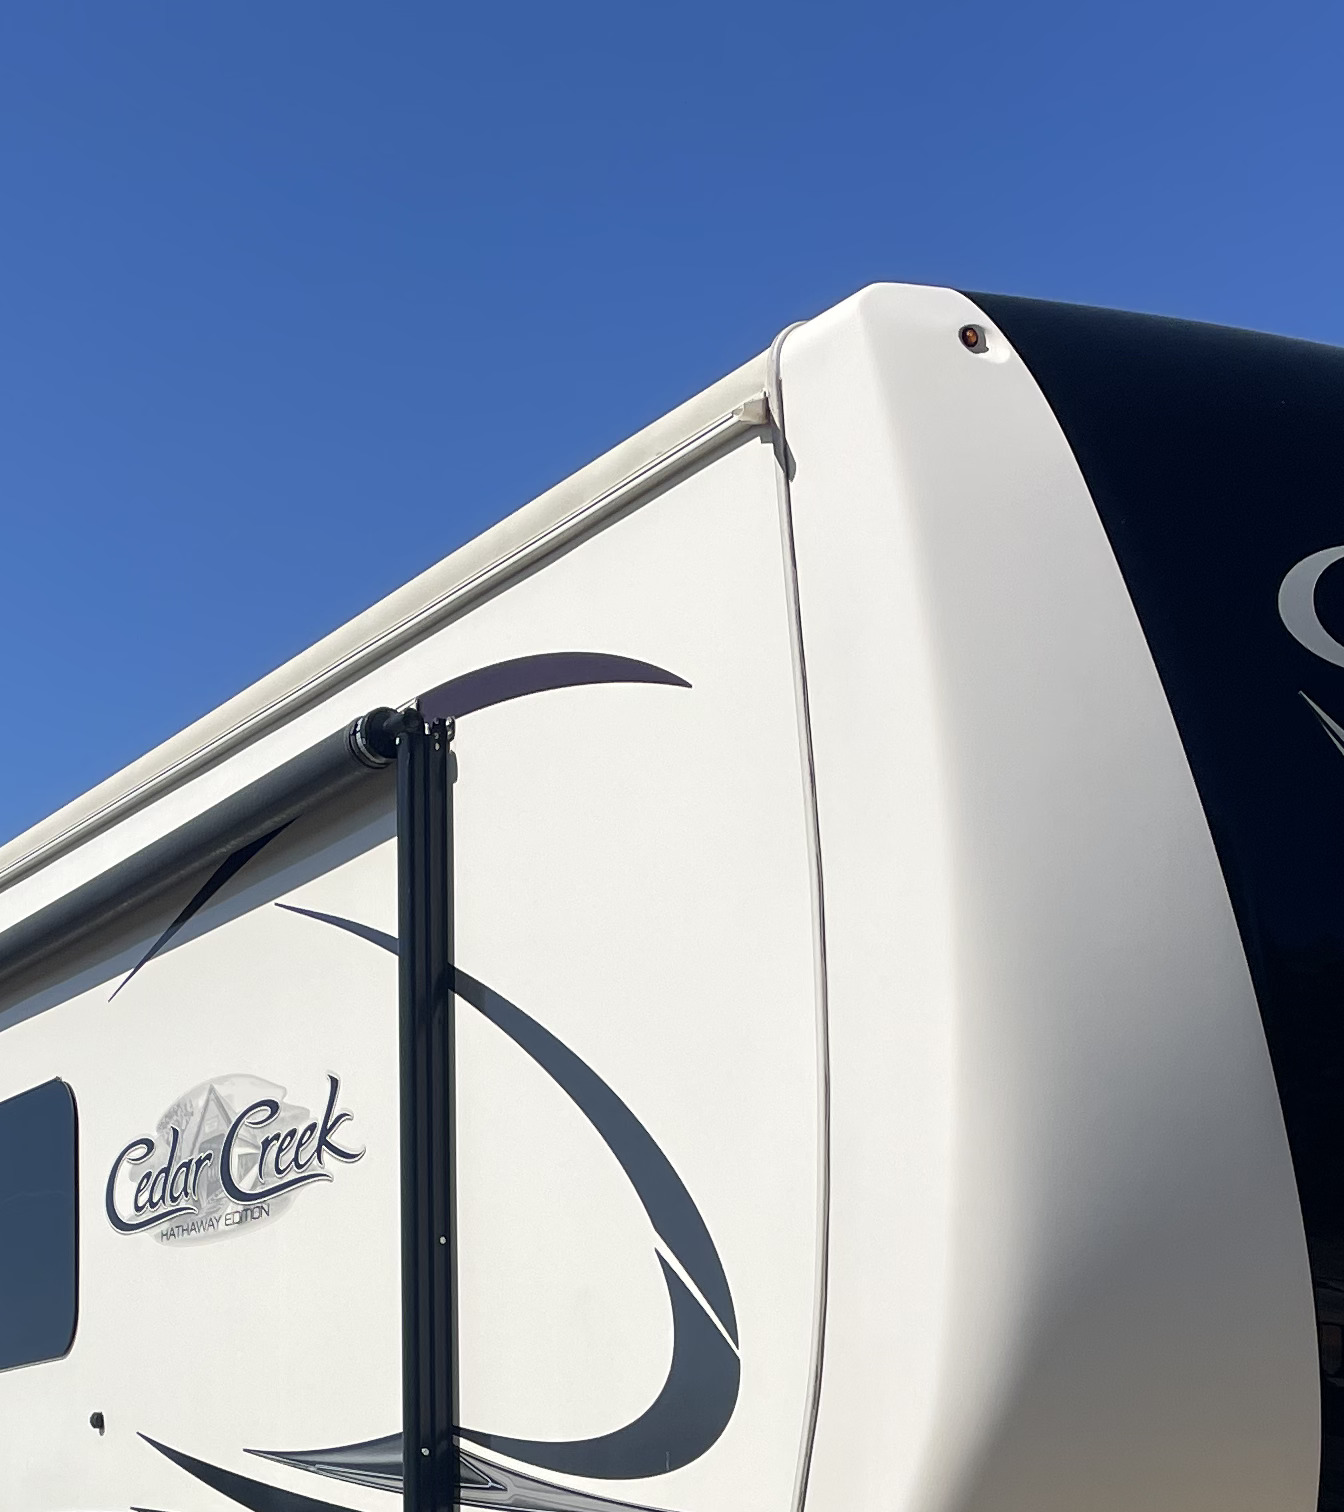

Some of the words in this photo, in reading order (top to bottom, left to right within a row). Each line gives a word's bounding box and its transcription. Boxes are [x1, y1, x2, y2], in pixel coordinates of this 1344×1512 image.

[105, 1125, 214, 1234] Cedar
[219, 1073, 365, 1203] Creek
[160, 1214, 222, 1243] HATHAWAY
[224, 1203, 271, 1228] EDITION
